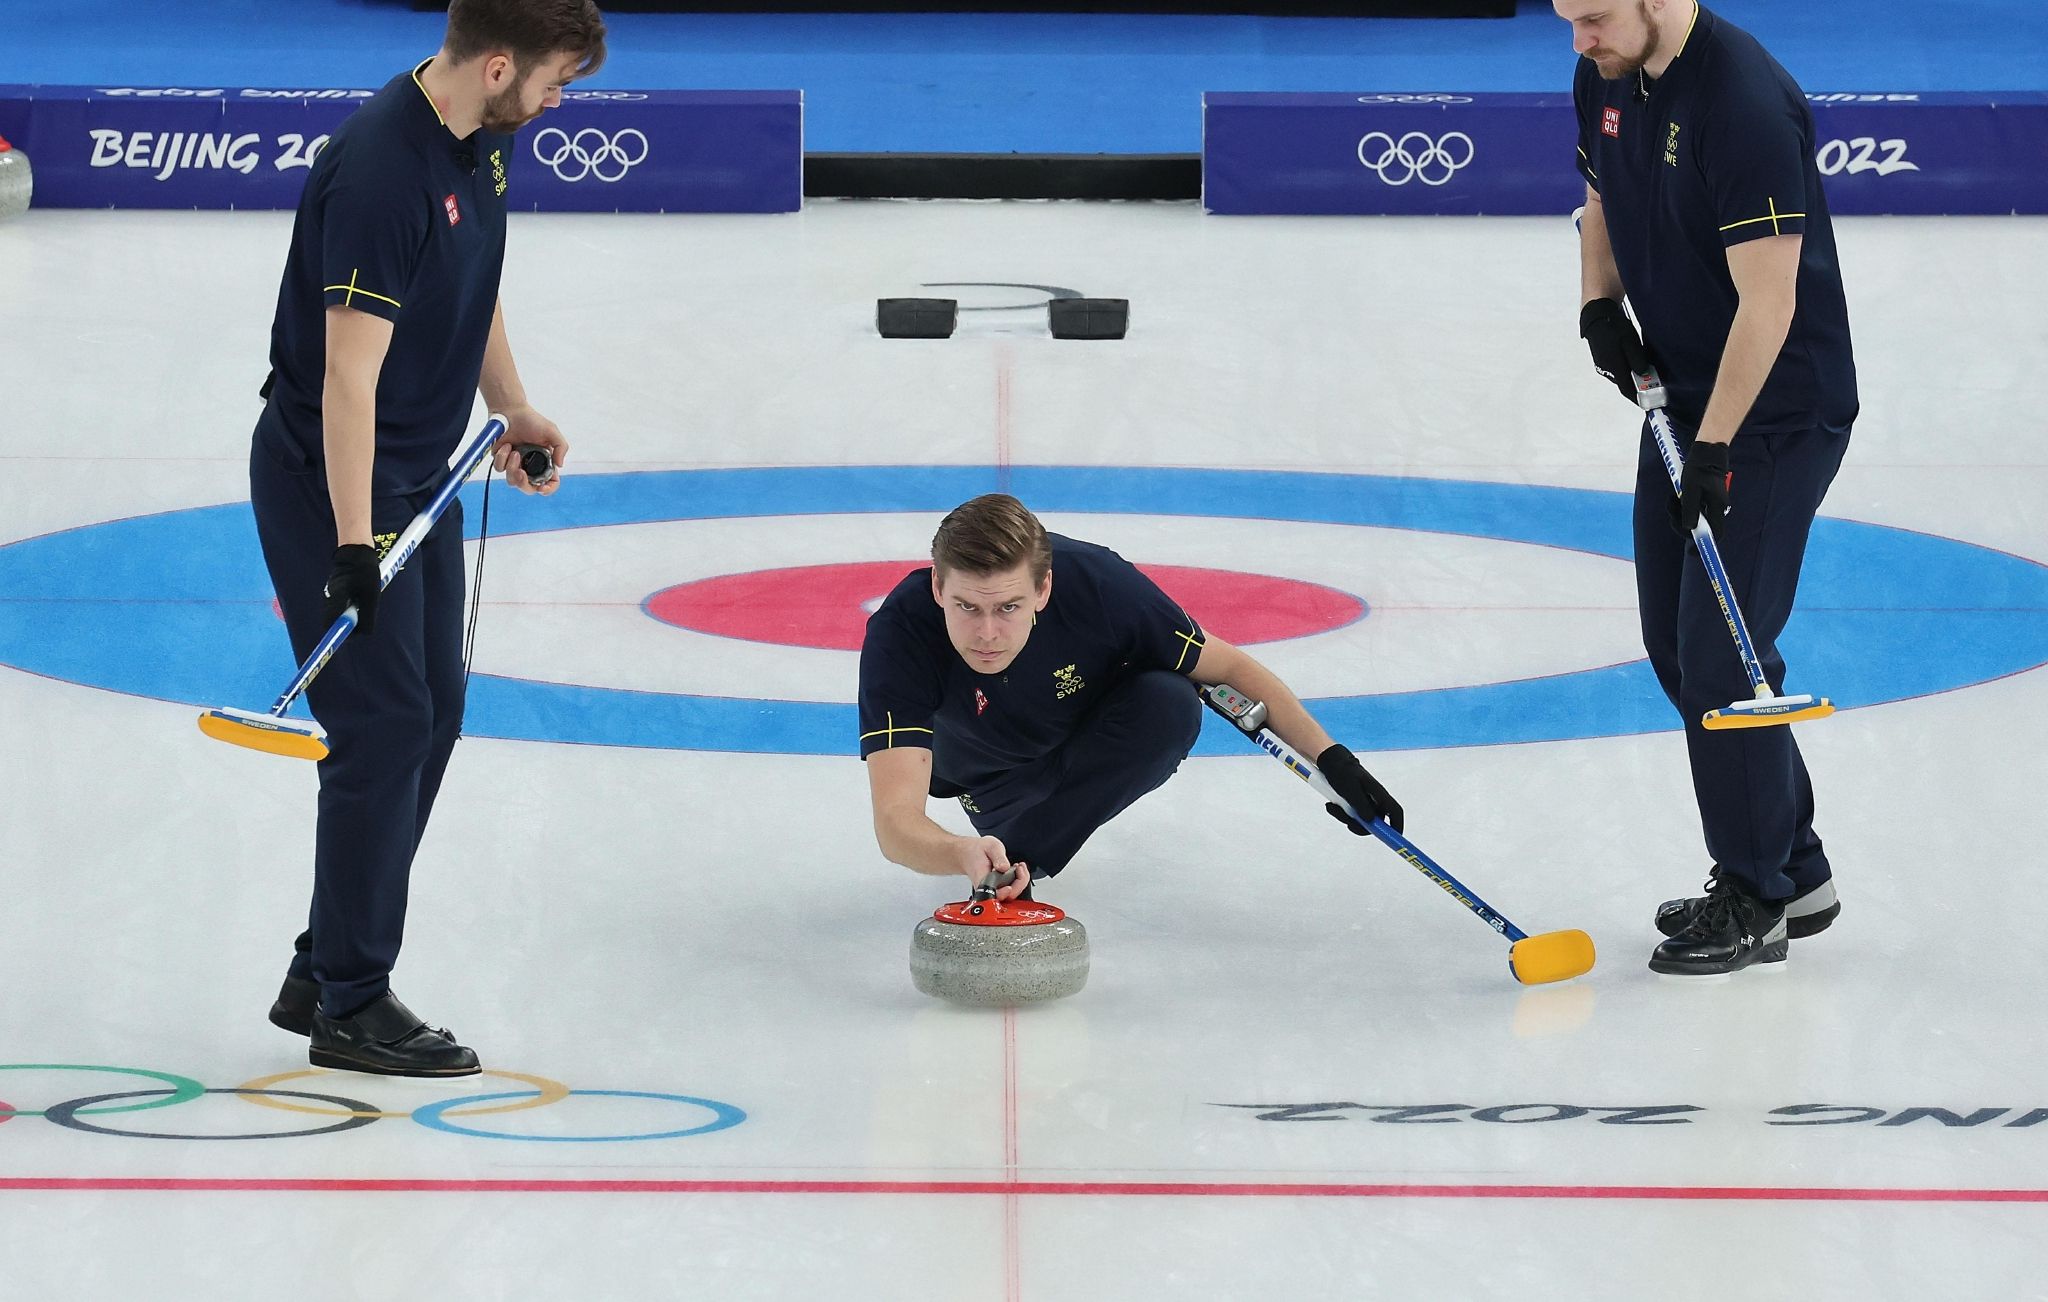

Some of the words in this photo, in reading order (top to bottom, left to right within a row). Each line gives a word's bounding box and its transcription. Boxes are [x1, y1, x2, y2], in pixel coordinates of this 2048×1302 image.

[1605, 110, 1619, 123] UNI
[1604, 121, 1618, 134] QLO
[89, 128, 260, 182] BEIJING
[1815, 136, 1921, 177] 022
[1056, 681, 1087, 699] SWE
[1752, 705, 1791, 714] SWEDEN
[241, 718, 279, 731] SWEDEN
[1395, 846, 1475, 908] Hardline
